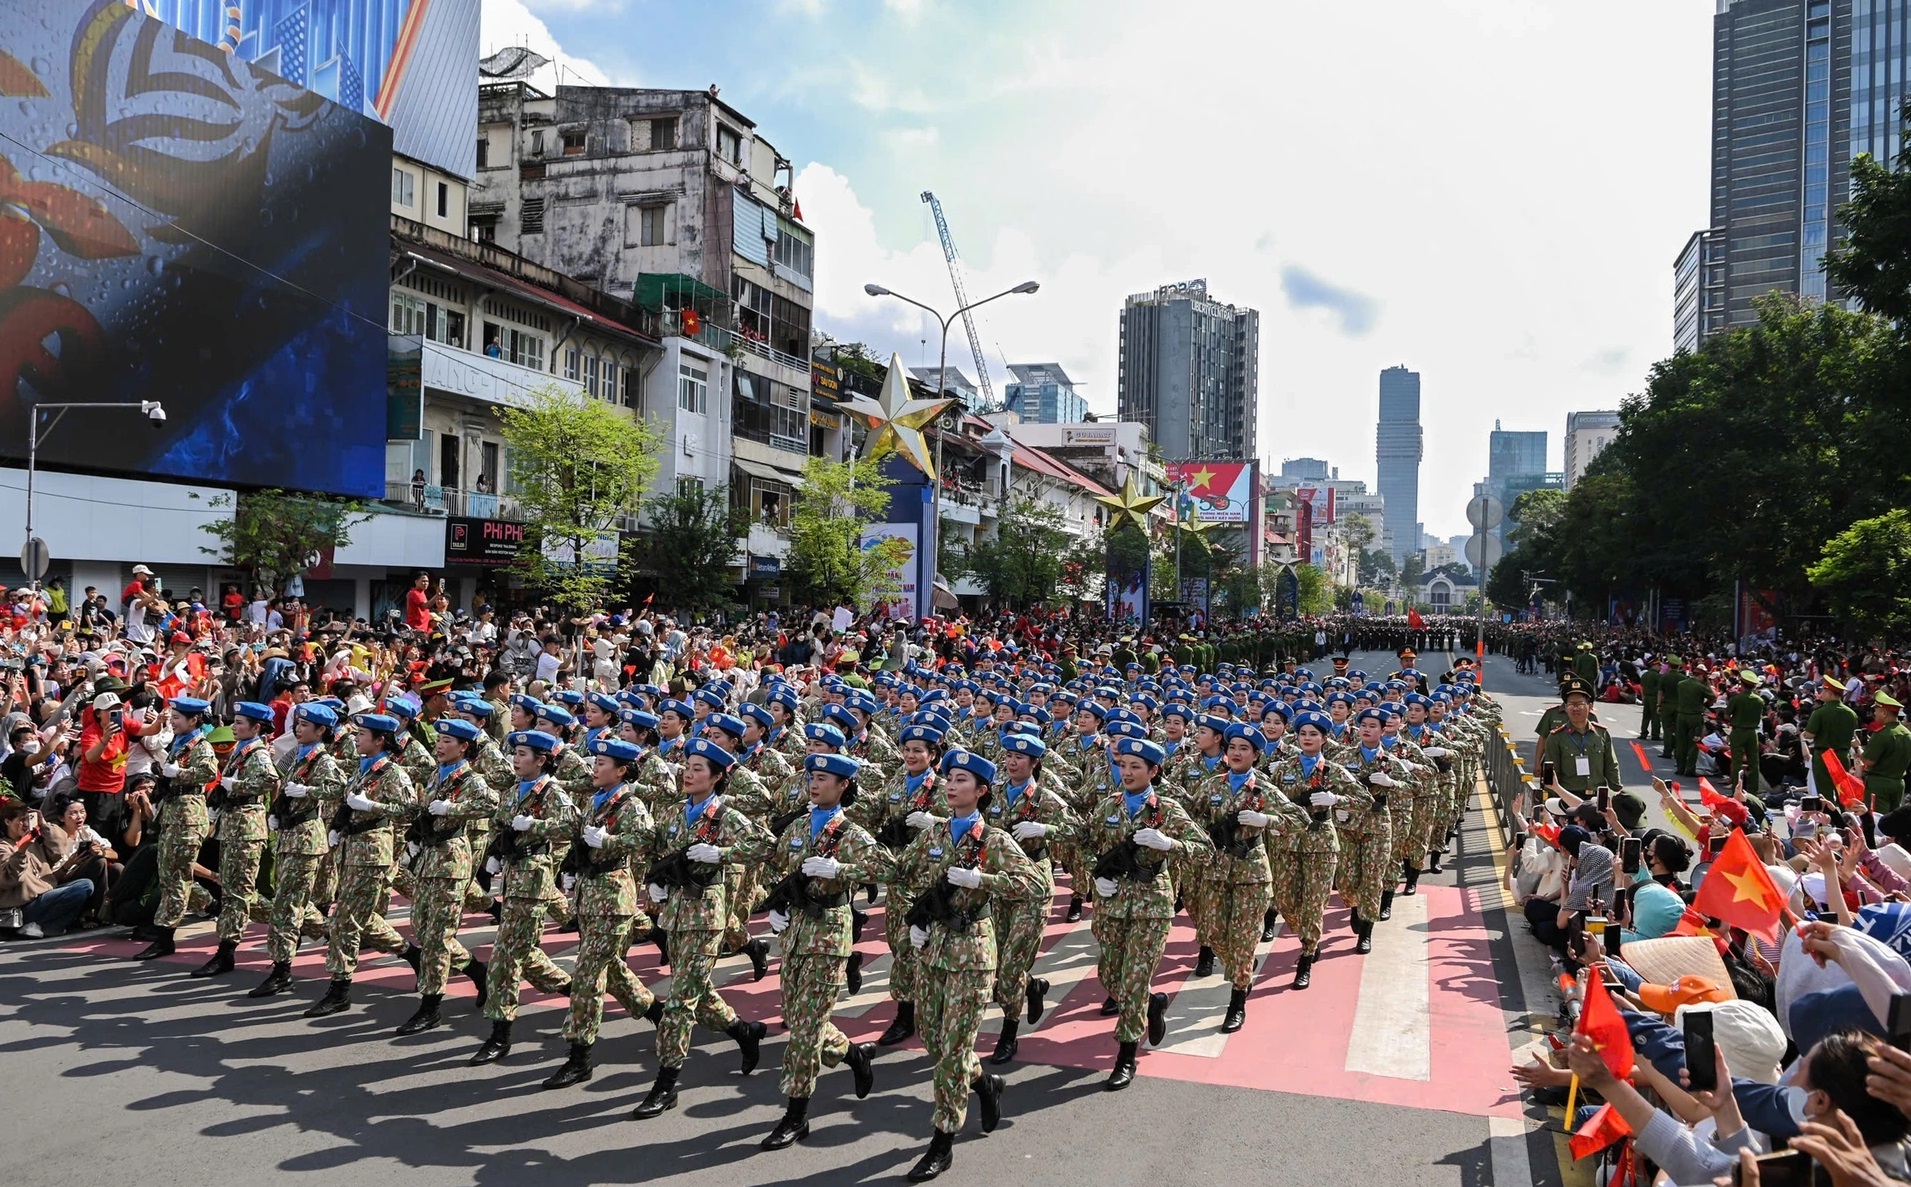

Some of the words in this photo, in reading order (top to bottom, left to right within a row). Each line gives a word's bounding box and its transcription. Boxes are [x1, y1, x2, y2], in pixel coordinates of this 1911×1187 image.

[1191, 301, 1211, 316] LIBERTY
[1211, 305, 1235, 322] CENTRAL
[902, 584, 915, 593] NAM
